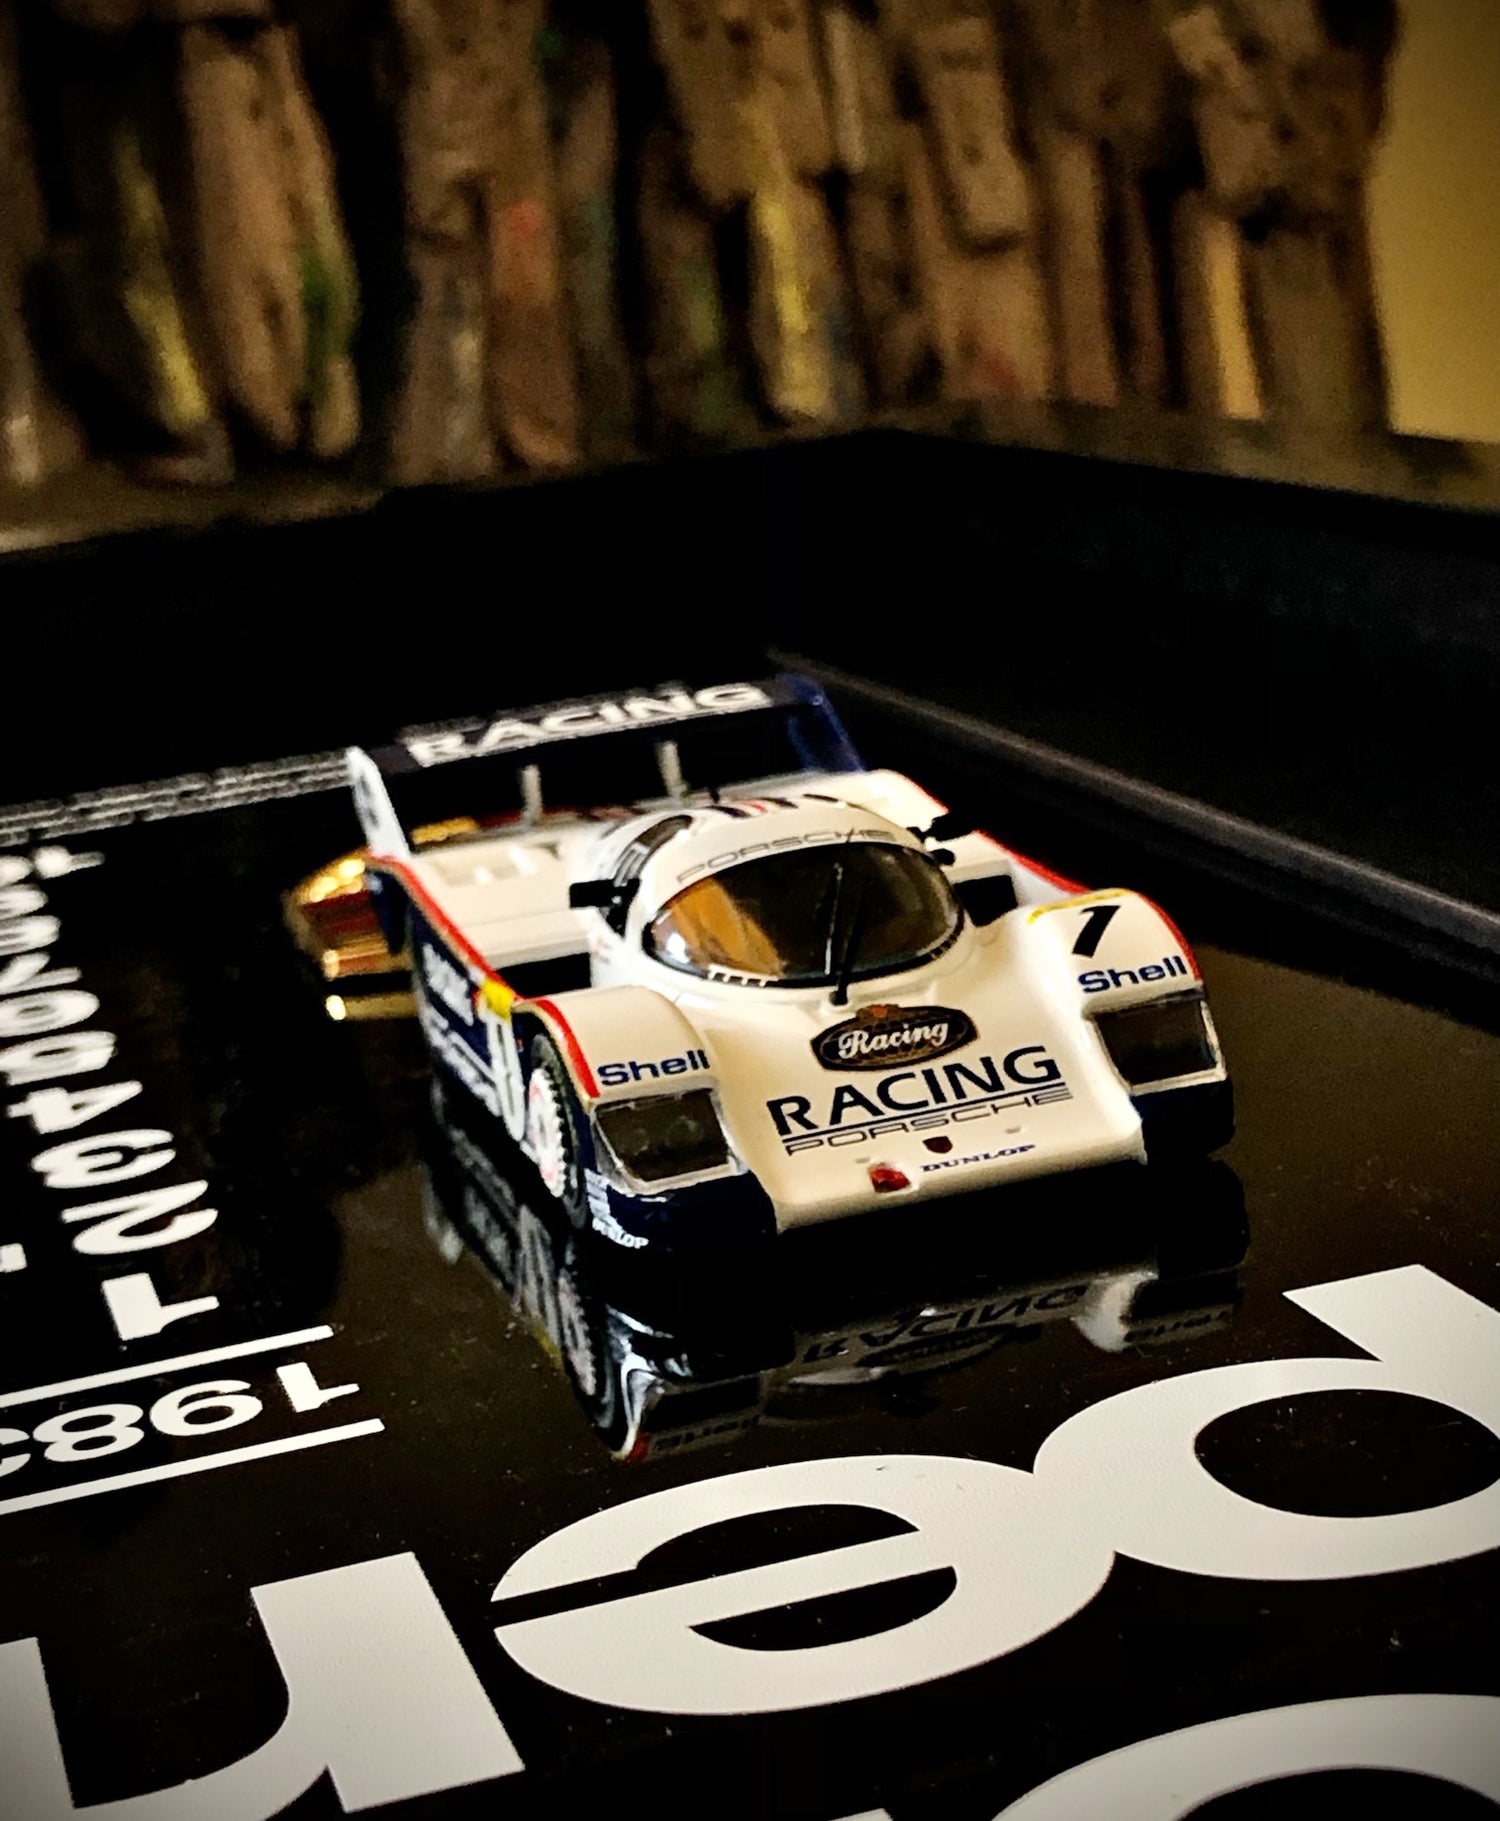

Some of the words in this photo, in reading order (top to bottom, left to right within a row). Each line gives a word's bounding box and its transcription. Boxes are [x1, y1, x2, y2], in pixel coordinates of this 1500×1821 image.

[405, 680, 773, 769] RACING
[676, 830, 898, 884] PORSCHE
[1072, 904, 1121, 959] 1
[1078, 955, 1189, 994] Shell
[598, 1048, 710, 1086] Shell
[837, 1018, 951, 1060] Racing
[766, 1044, 1062, 1137] RACING
[785, 1084, 1074, 1156] PORSCHE
[30, 1129, 176, 1189] 3
[921, 1144, 1036, 1172] DUNLOP
[60, 1179, 219, 1255] 2
[101, 1272, 220, 1341] 1
